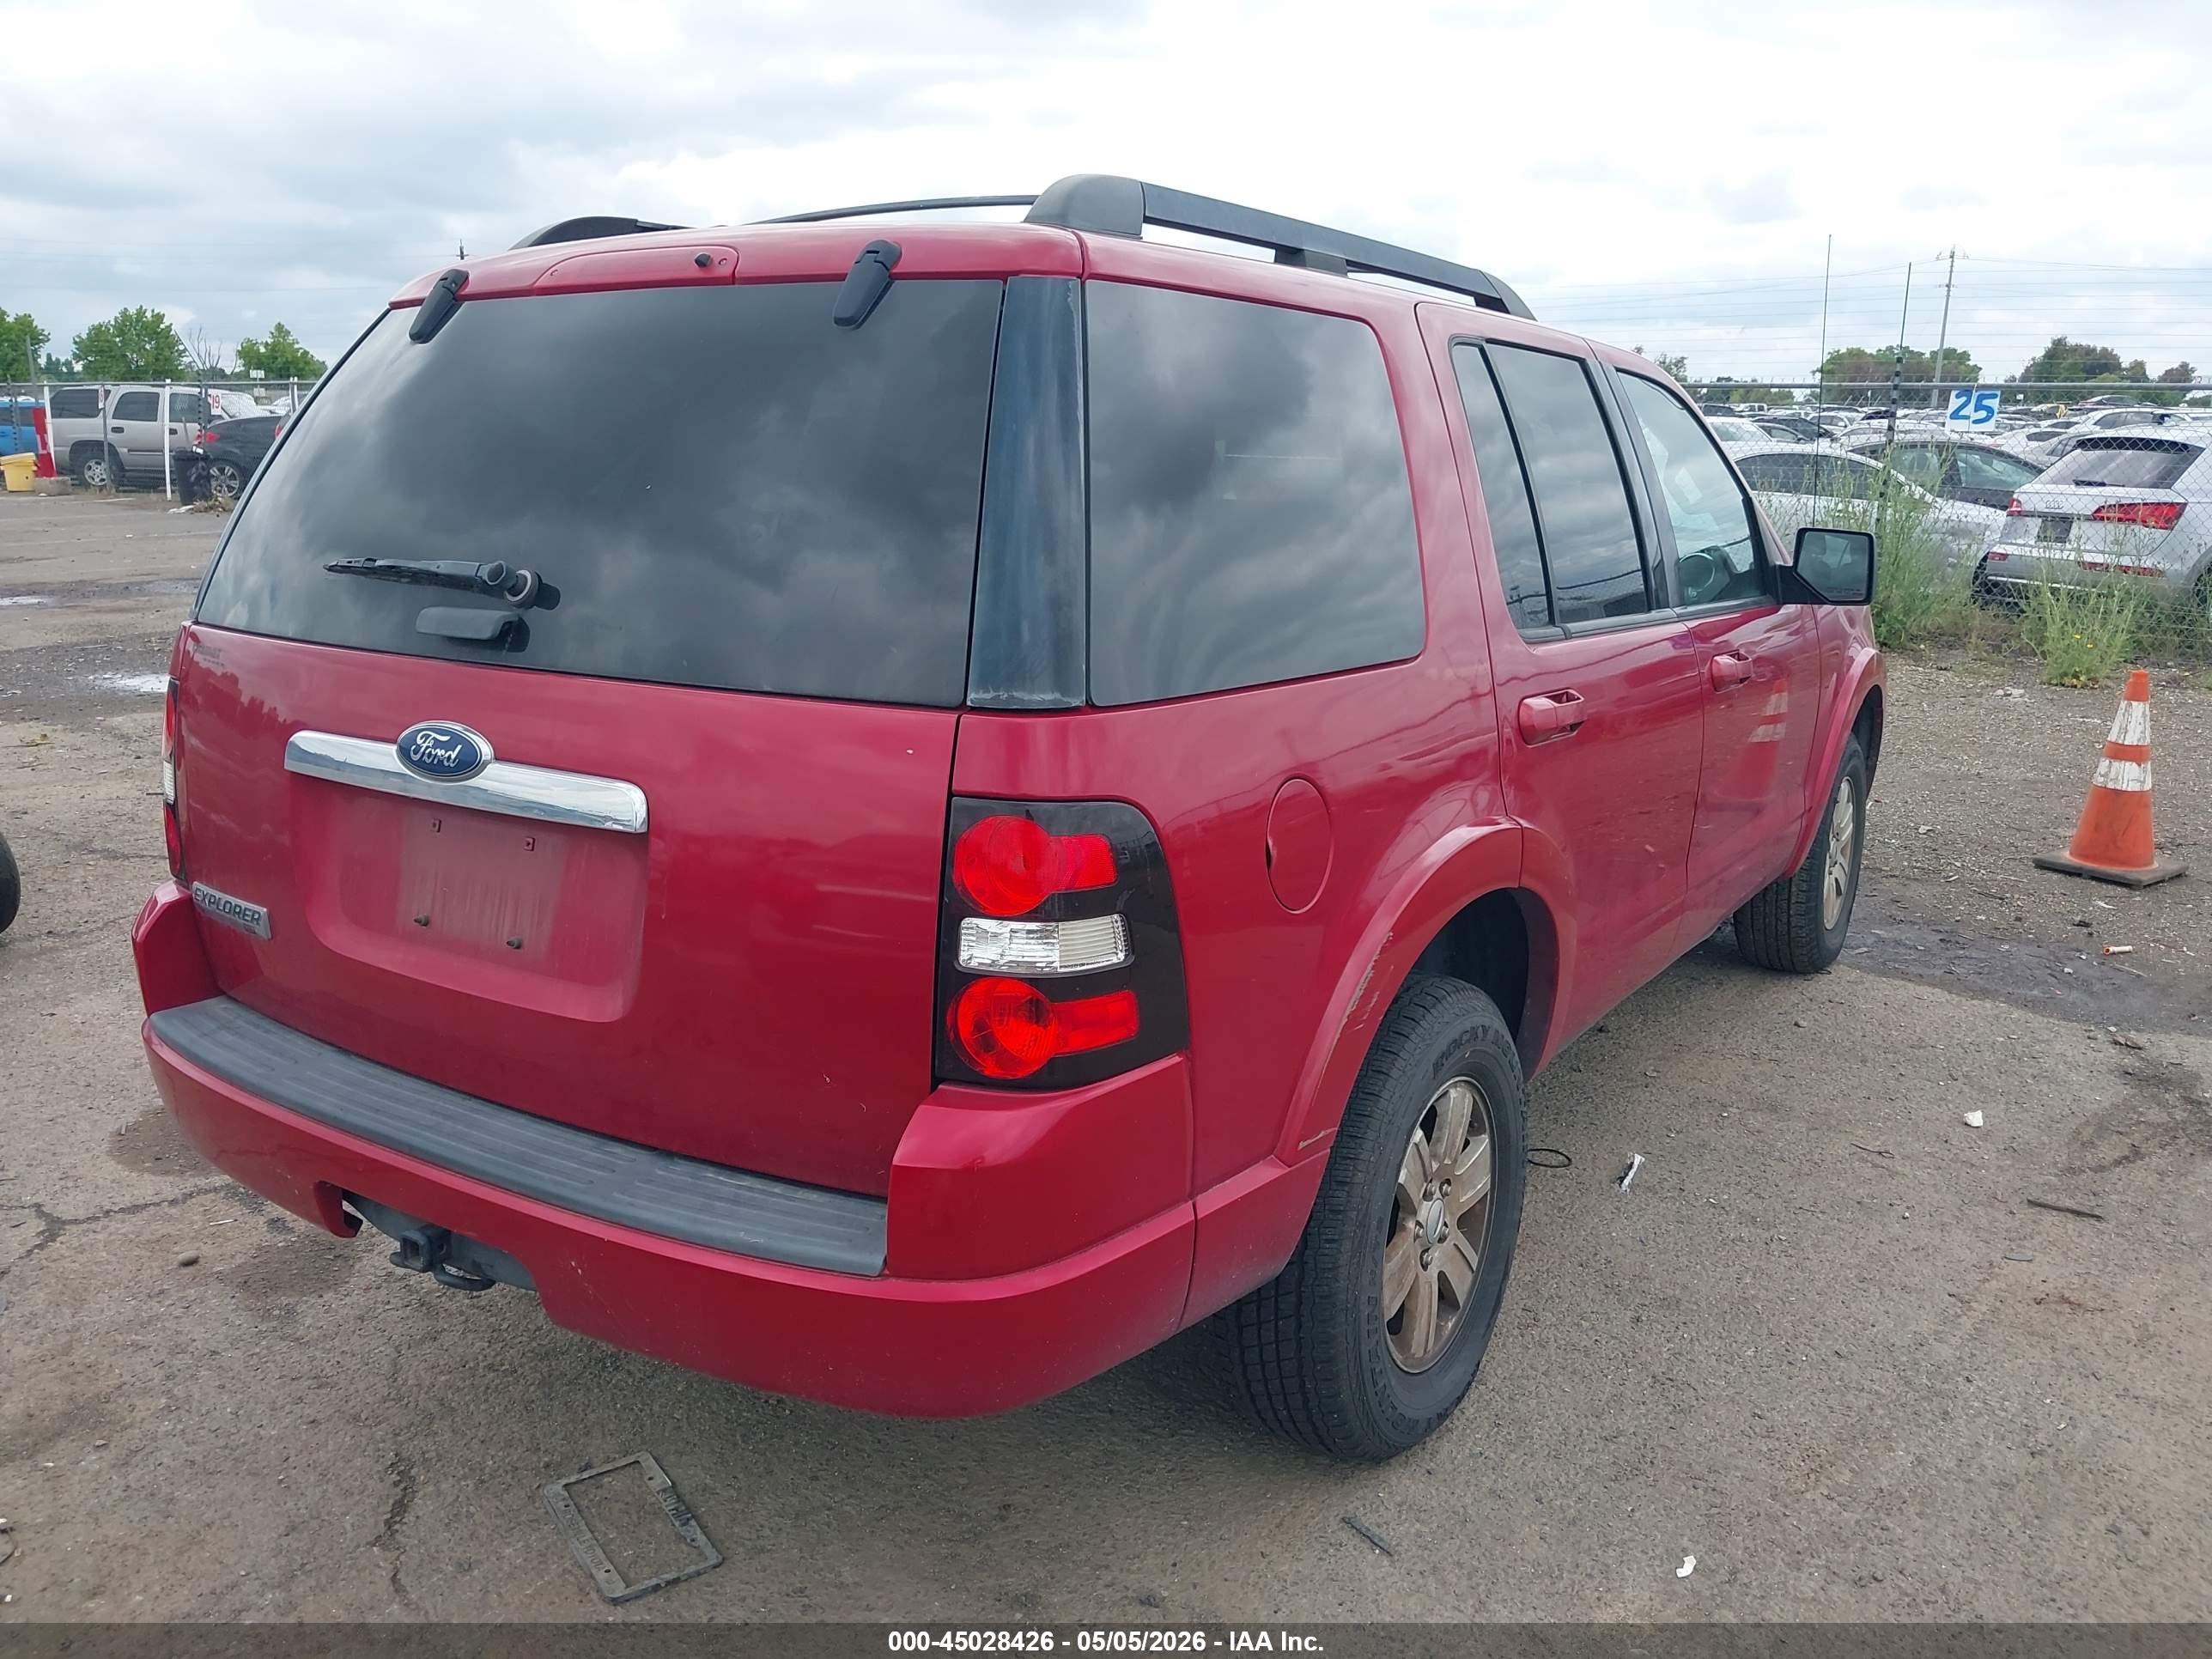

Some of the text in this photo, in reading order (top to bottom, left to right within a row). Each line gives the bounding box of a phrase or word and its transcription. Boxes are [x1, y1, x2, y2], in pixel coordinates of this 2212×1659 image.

[1949, 389, 1999, 424] 25
[410, 731, 462, 768] Ford
[193, 887, 262, 926] EXPLORER
